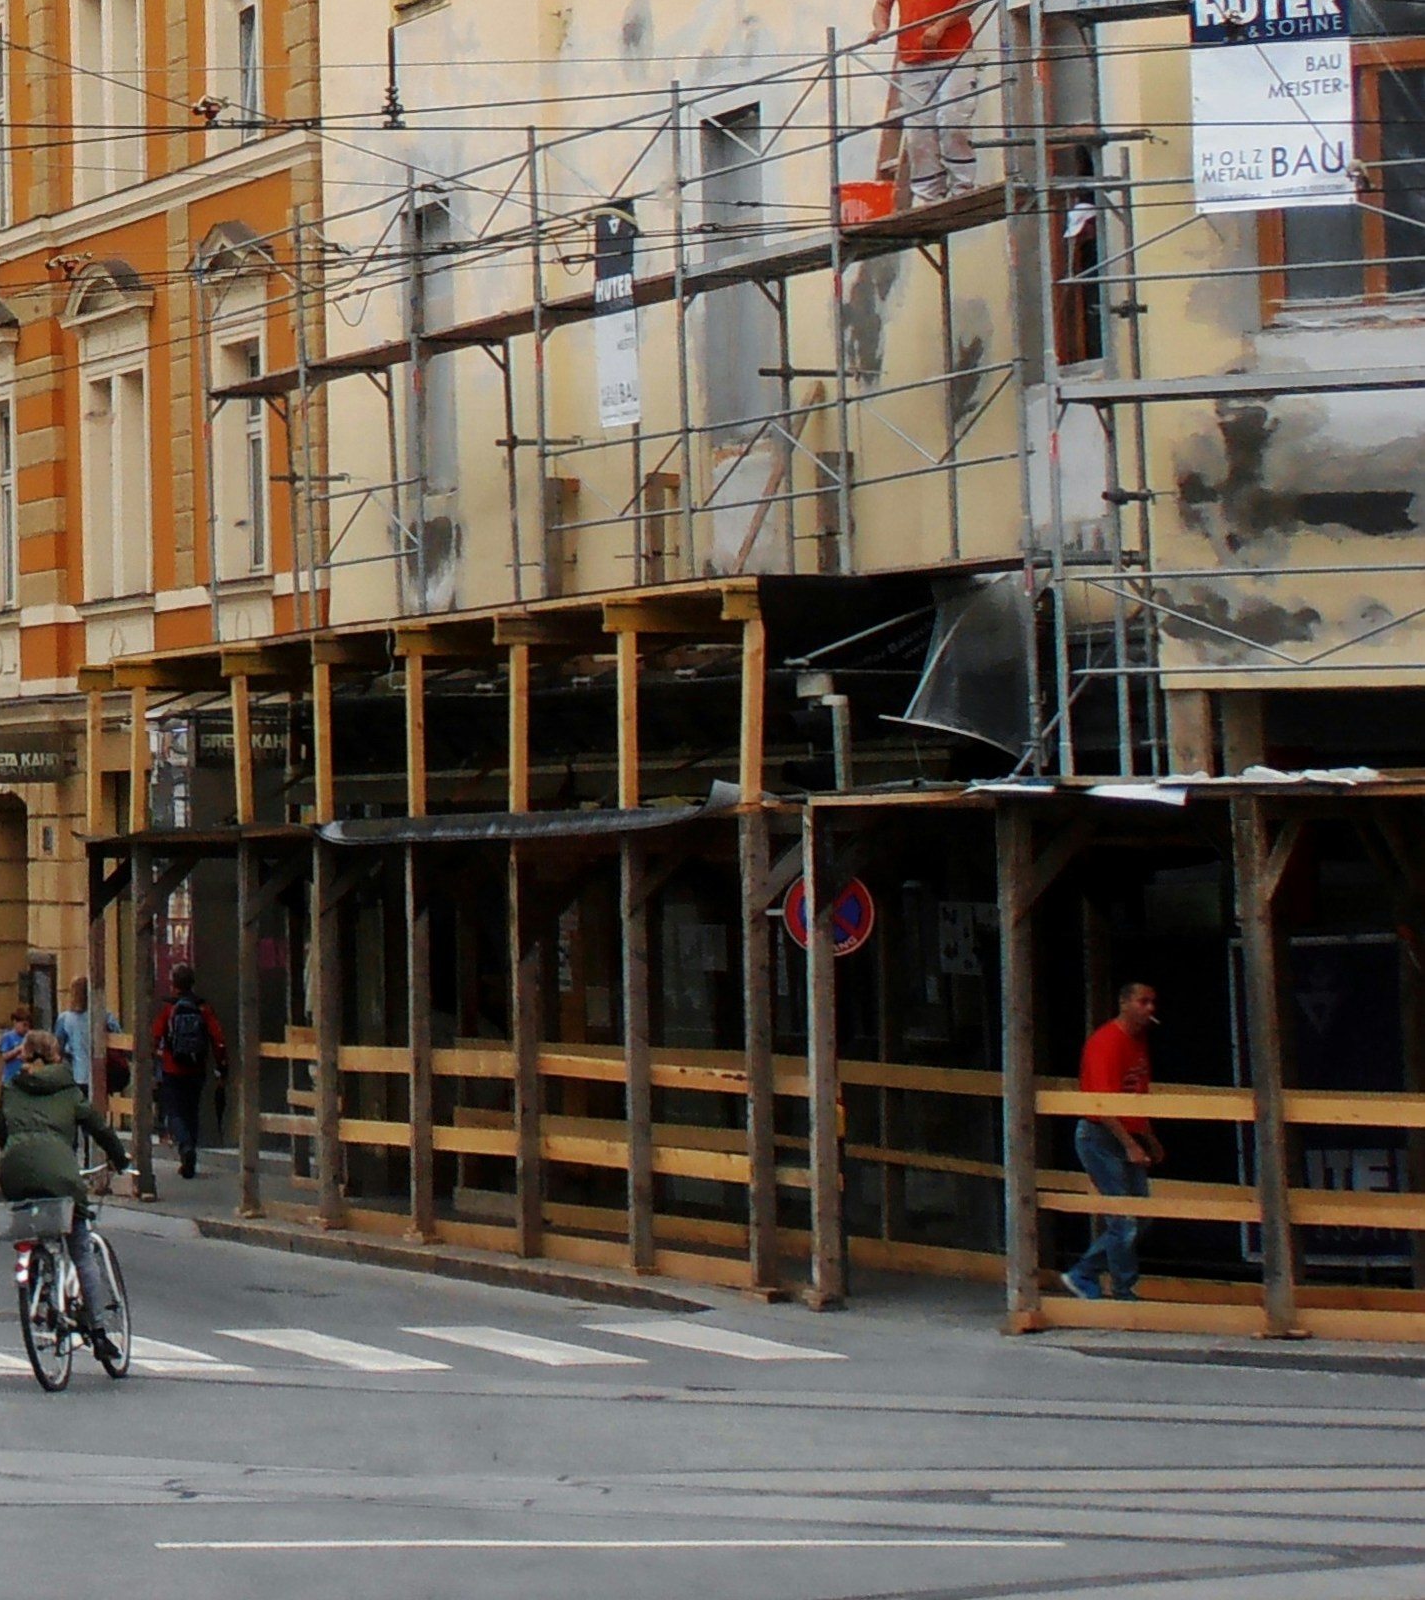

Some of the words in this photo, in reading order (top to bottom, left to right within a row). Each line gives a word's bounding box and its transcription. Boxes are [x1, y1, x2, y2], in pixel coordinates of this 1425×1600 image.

[1249, 26, 1260, 38] &
[1306, 53, 1342, 72] BAU
[1268, 77, 1342, 99] MEISTER
[1202, 149, 1262, 167] HOLZ
[1271, 141, 1344, 178] BAU
[1202, 166, 1264, 183] METALL
[595, 273, 634, 303] HUTER
